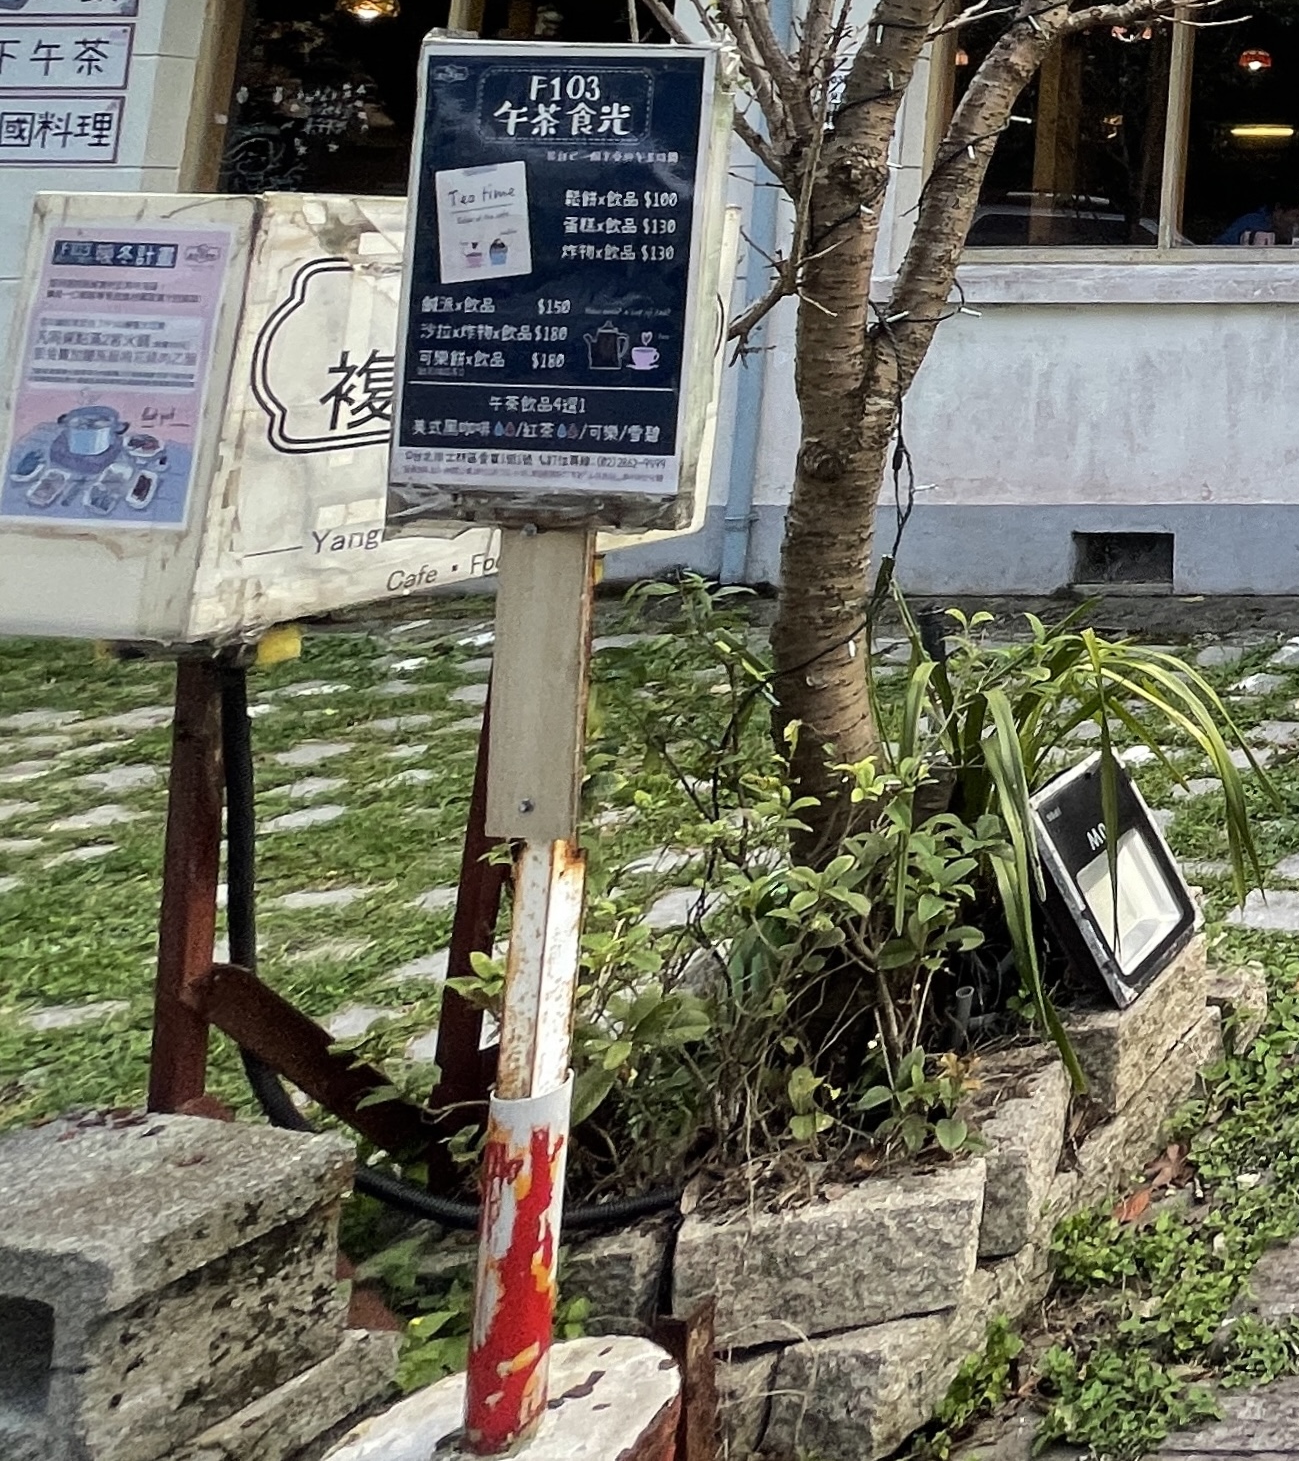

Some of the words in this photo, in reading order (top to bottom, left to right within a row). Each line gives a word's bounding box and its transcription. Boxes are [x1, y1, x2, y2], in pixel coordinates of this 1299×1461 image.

[530, 75, 601, 101] F103
[493, 101, 632, 136] 午茶食光
[0, 111, 114, 149] 國料理
[643, 191, 678, 208] $100
[642, 218, 676, 235] $130
[640, 244, 675, 262] $130
[537, 297, 571, 315] $150
[534, 324, 568, 342] $180
[386, 564, 439, 591] Cafe
